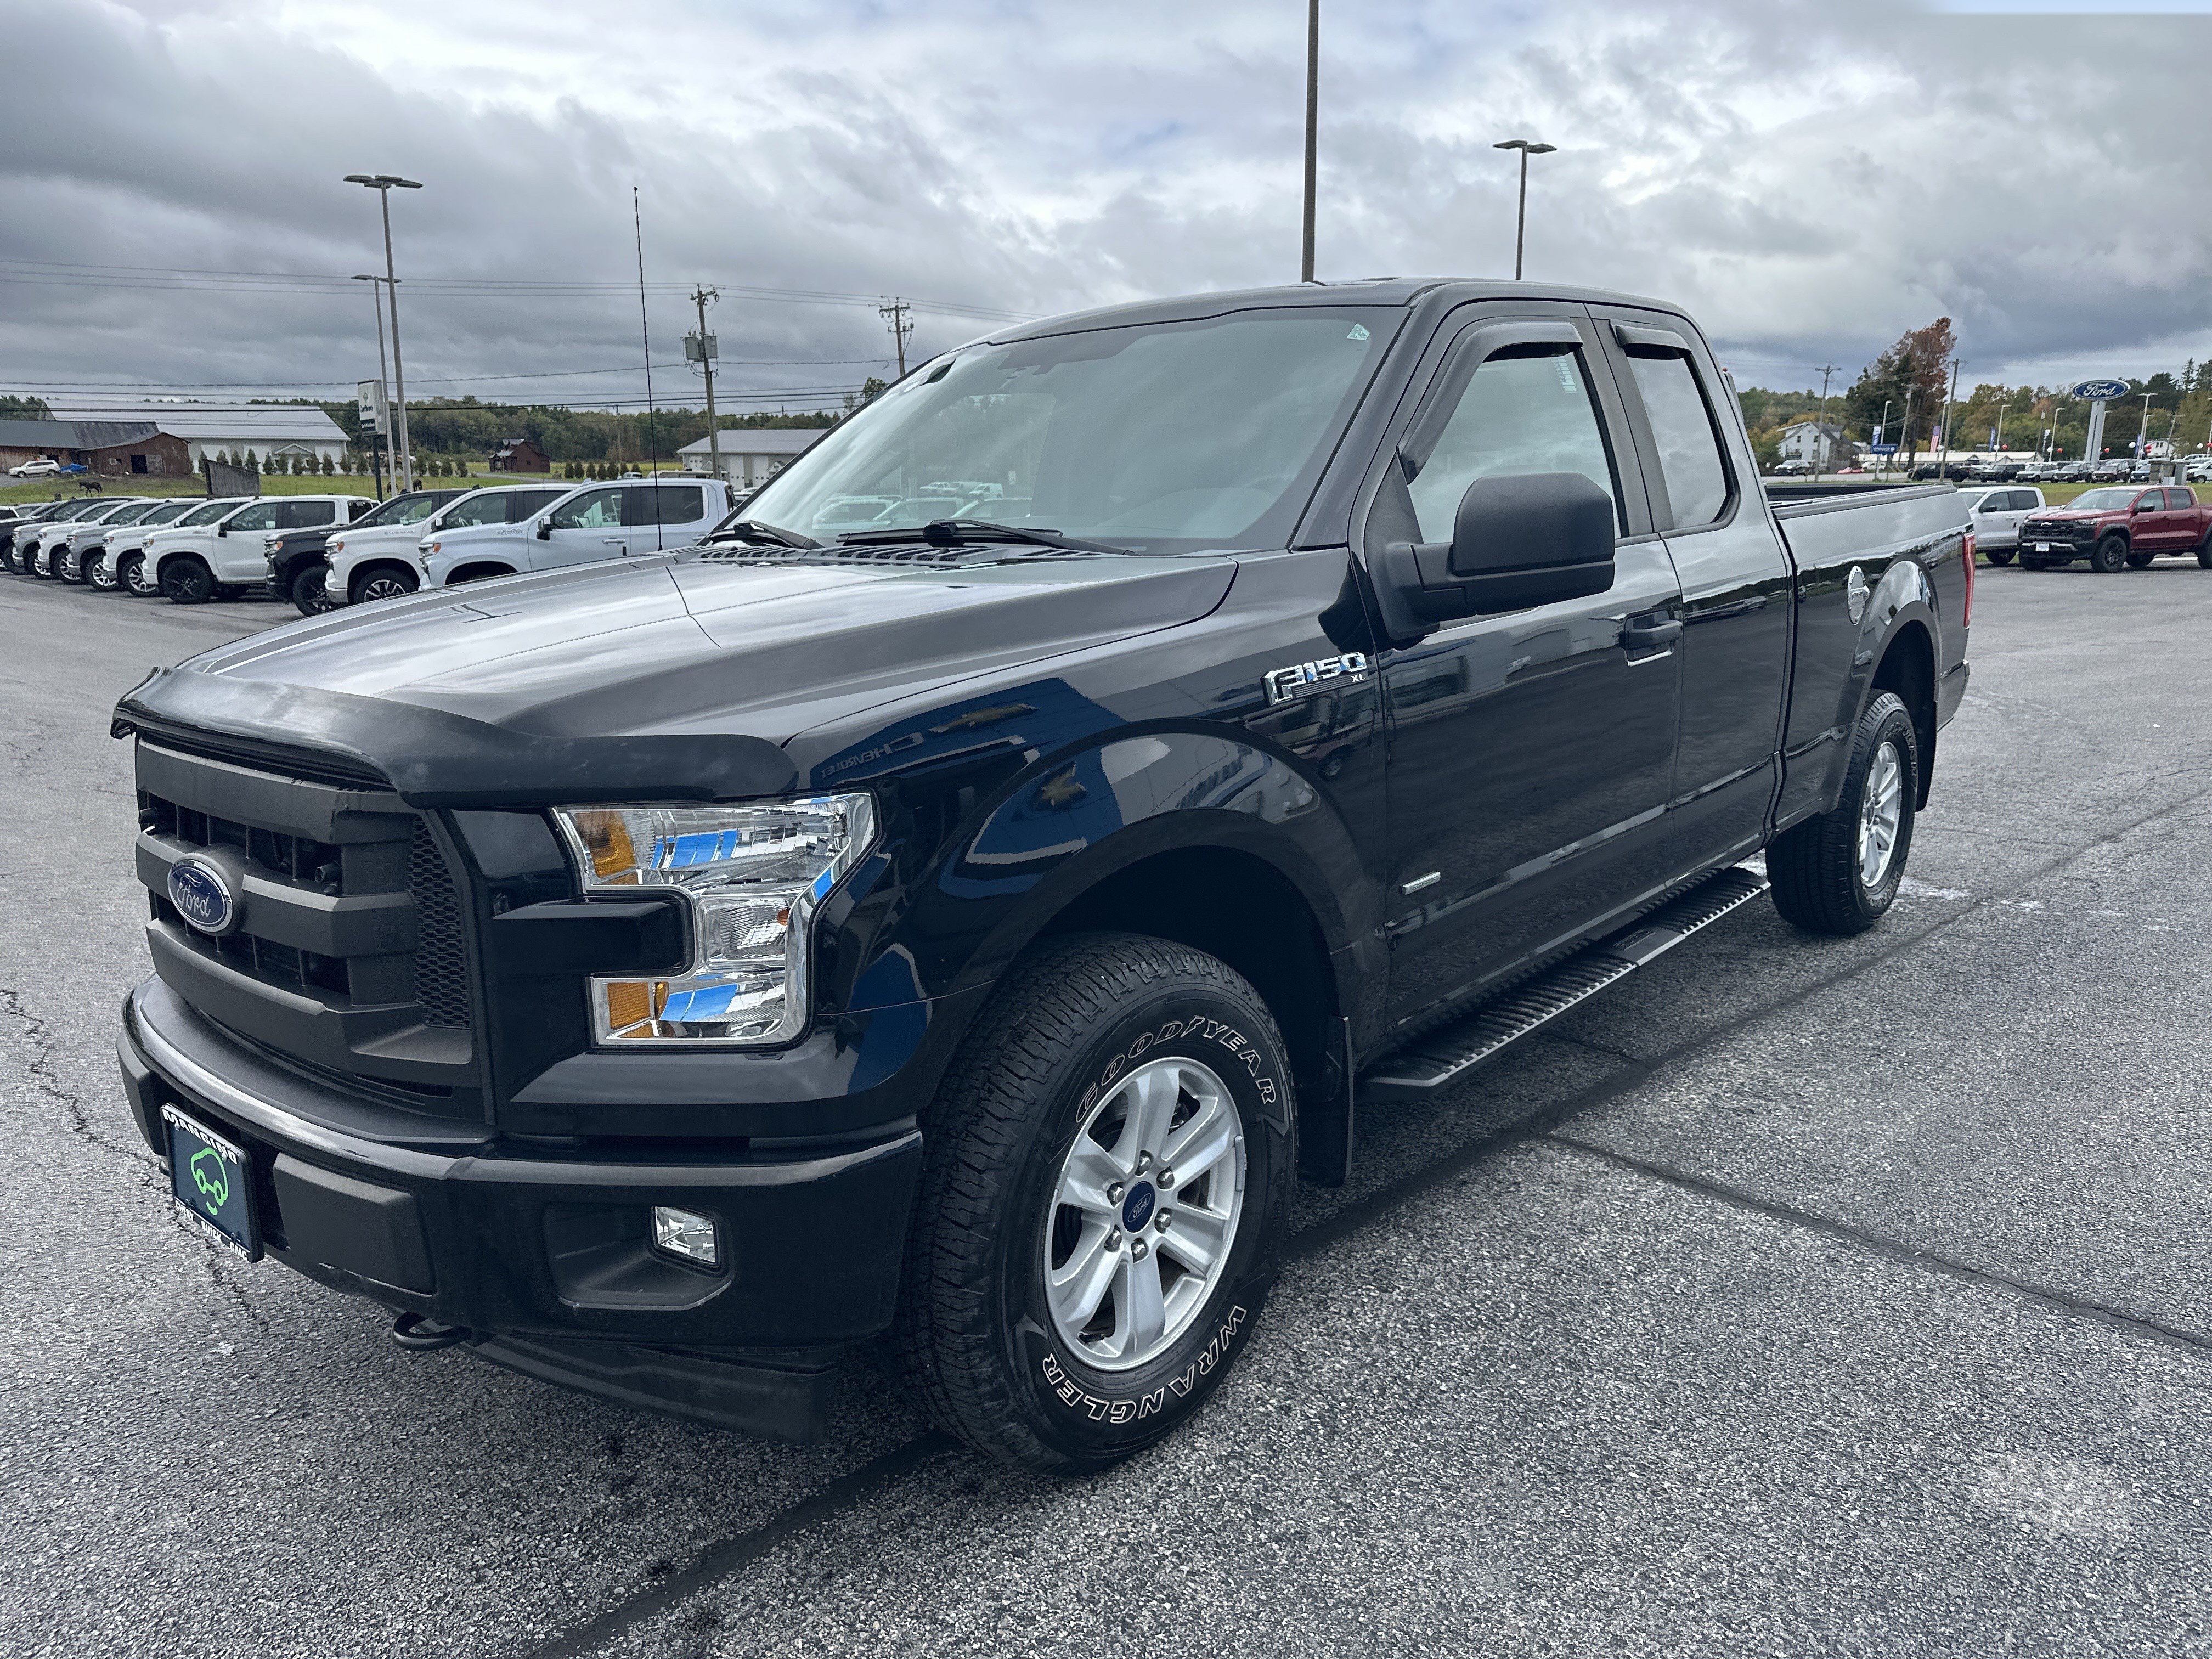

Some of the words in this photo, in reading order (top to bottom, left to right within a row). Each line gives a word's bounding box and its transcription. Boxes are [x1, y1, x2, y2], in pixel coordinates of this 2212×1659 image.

[2083, 383, 2117, 397] Ford
[1350, 673, 1366, 683] XL
[177, 873, 211, 917] Ford
[1075, 1015, 1277, 1123] GOODYEAR
[162, 1108, 238, 1165] MANGINO
[174, 1200, 195, 1222] CHEVY
[201, 1220, 222, 1244] BUICK
[229, 1242, 248, 1261] GMC
[1133, 1197, 1148, 1218] Ford
[1042, 1305, 1248, 1424] WRANGLER
